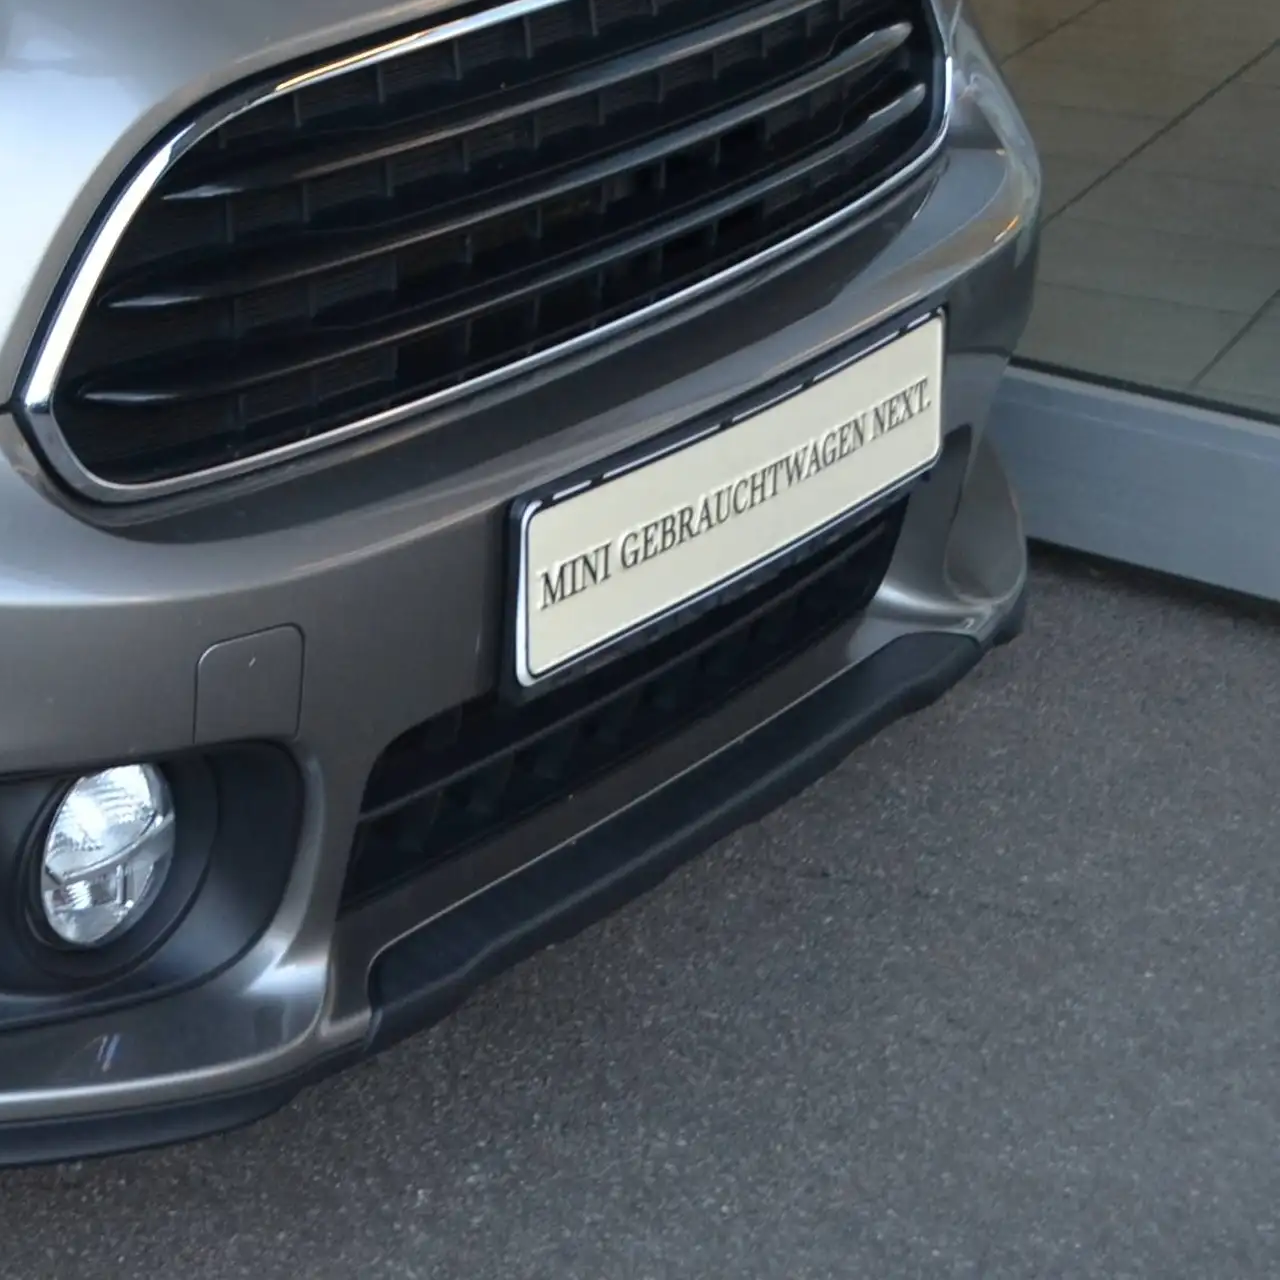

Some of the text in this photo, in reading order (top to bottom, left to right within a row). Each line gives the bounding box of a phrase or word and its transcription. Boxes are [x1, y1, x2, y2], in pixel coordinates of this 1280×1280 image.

[540, 377, 932, 610] MINI GEBRAUCHTWAGEN NEXT.
